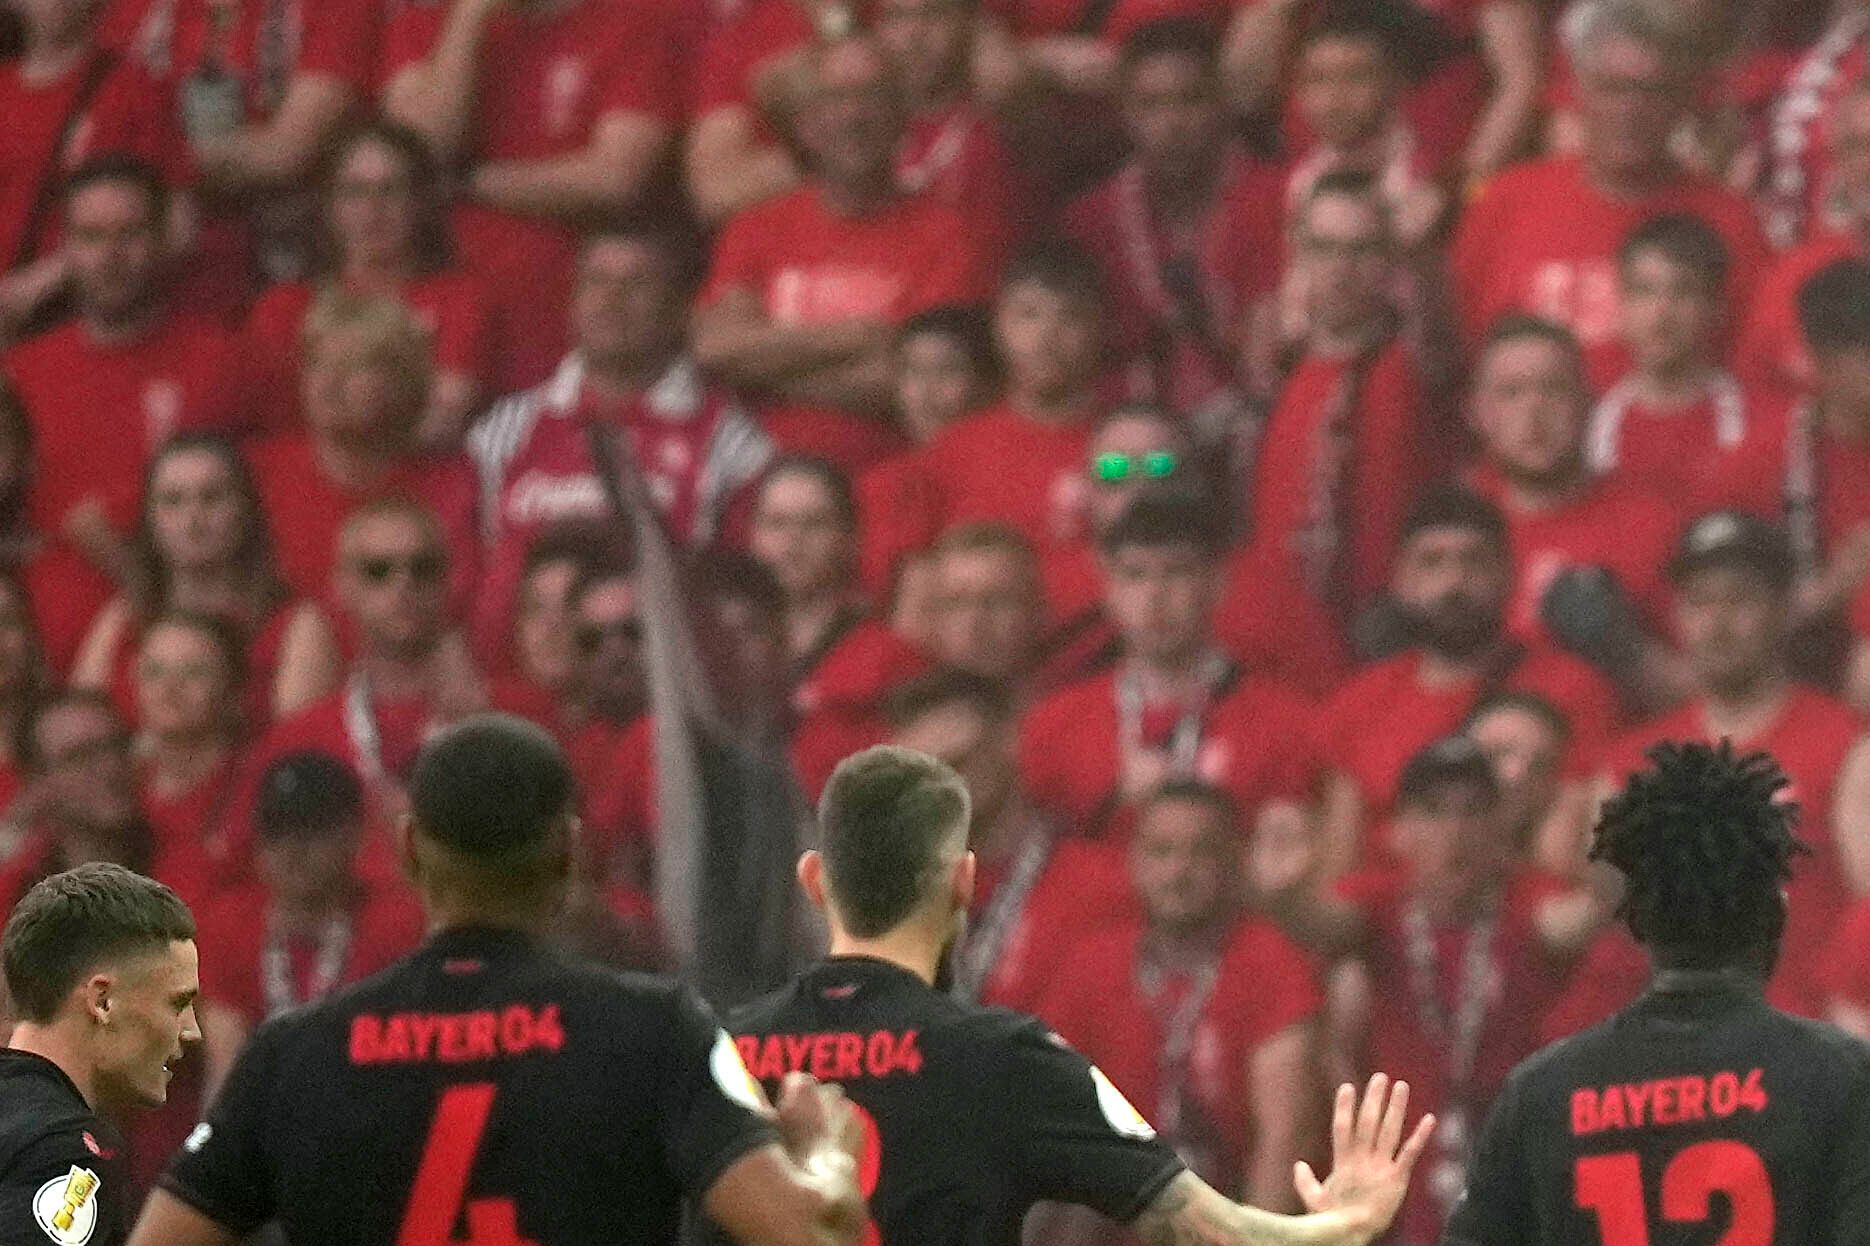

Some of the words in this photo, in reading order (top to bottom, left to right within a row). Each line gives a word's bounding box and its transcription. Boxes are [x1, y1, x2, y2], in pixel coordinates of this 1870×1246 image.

[348, 1010, 498, 1065] BAYER
[501, 1004, 567, 1055] 04
[734, 1031, 865, 1080] BAYER
[1570, 1075, 1706, 1136] BAYER
[1709, 1067, 1769, 1118] 04
